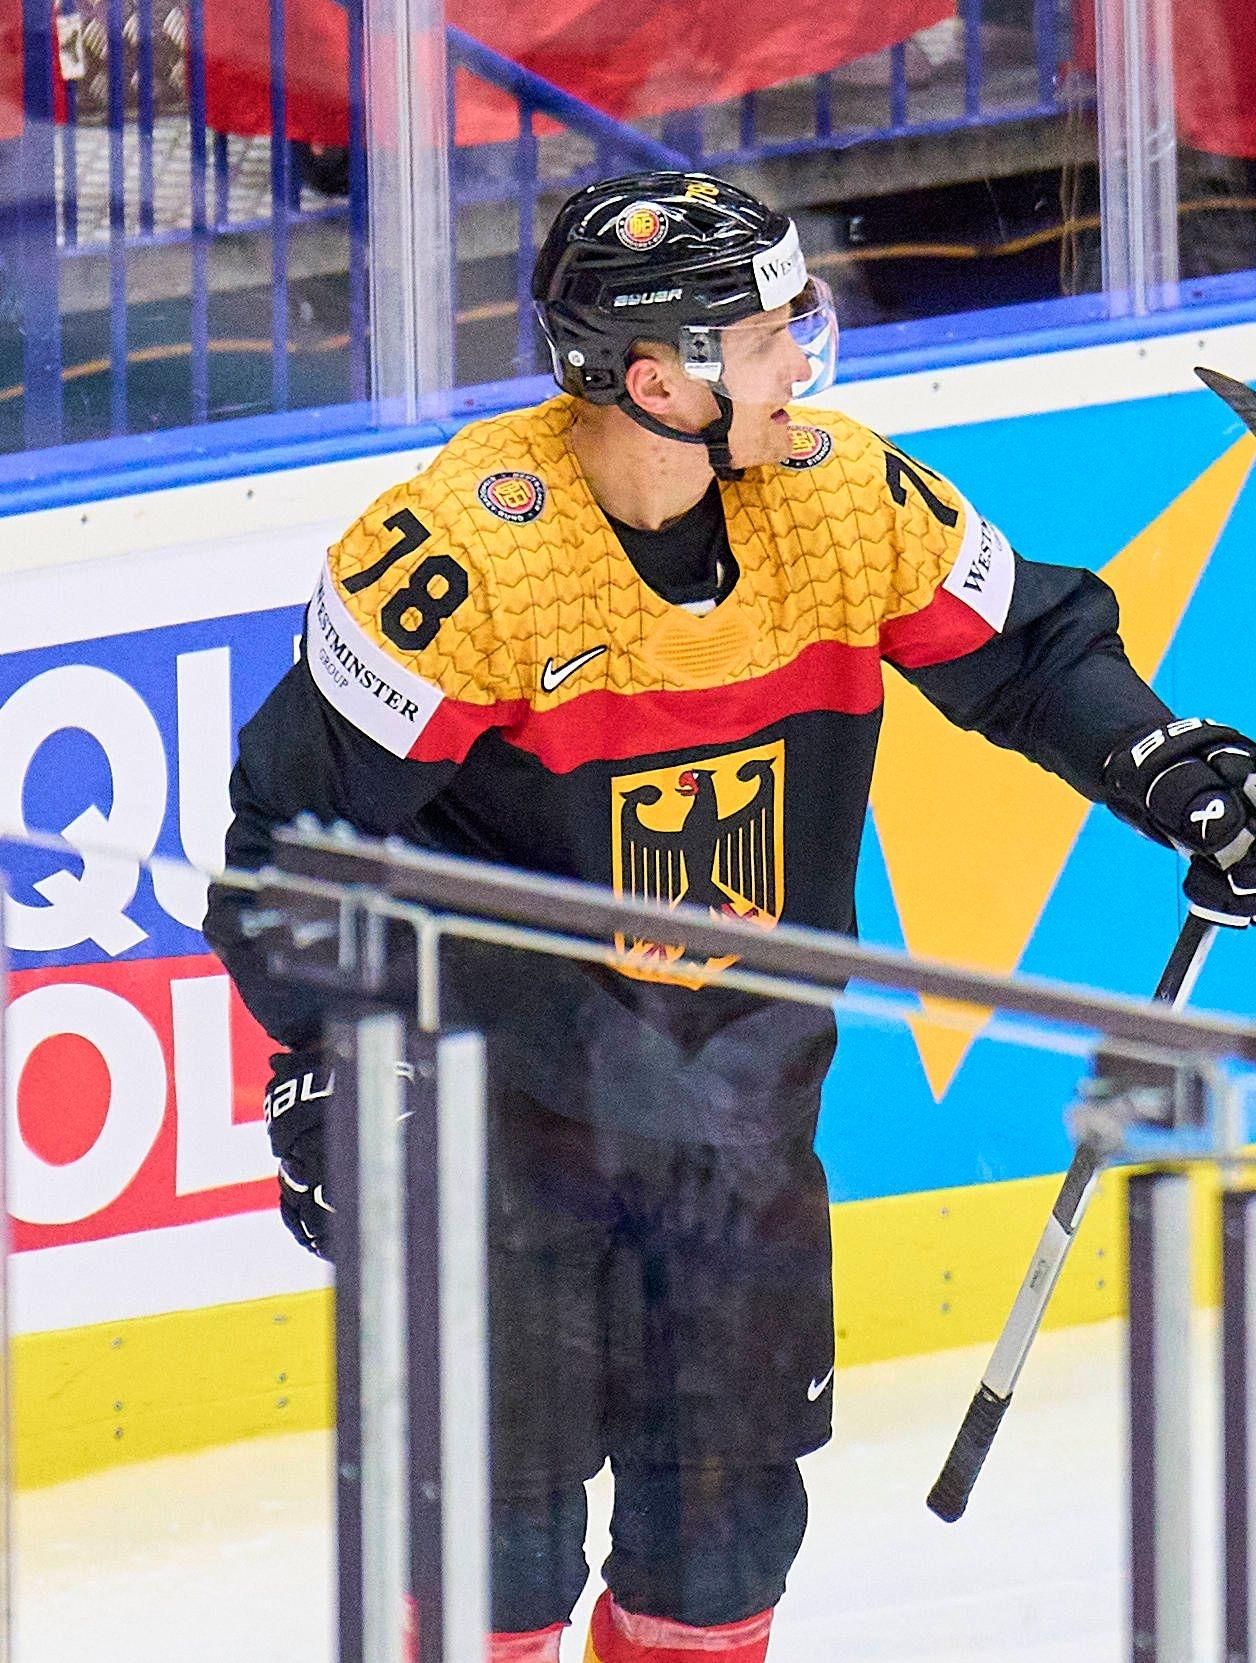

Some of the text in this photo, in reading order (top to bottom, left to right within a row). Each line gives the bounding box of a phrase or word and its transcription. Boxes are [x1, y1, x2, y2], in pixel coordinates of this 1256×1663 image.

[613, 288, 682, 307] BAUER
[872, 432, 958, 528] 7
[341, 507, 468, 651] 78
[963, 519, 992, 592] WEST
[319, 648, 349, 688] GROUP
[1131, 717, 1216, 768] BA
[0, 636, 302, 957] QU
